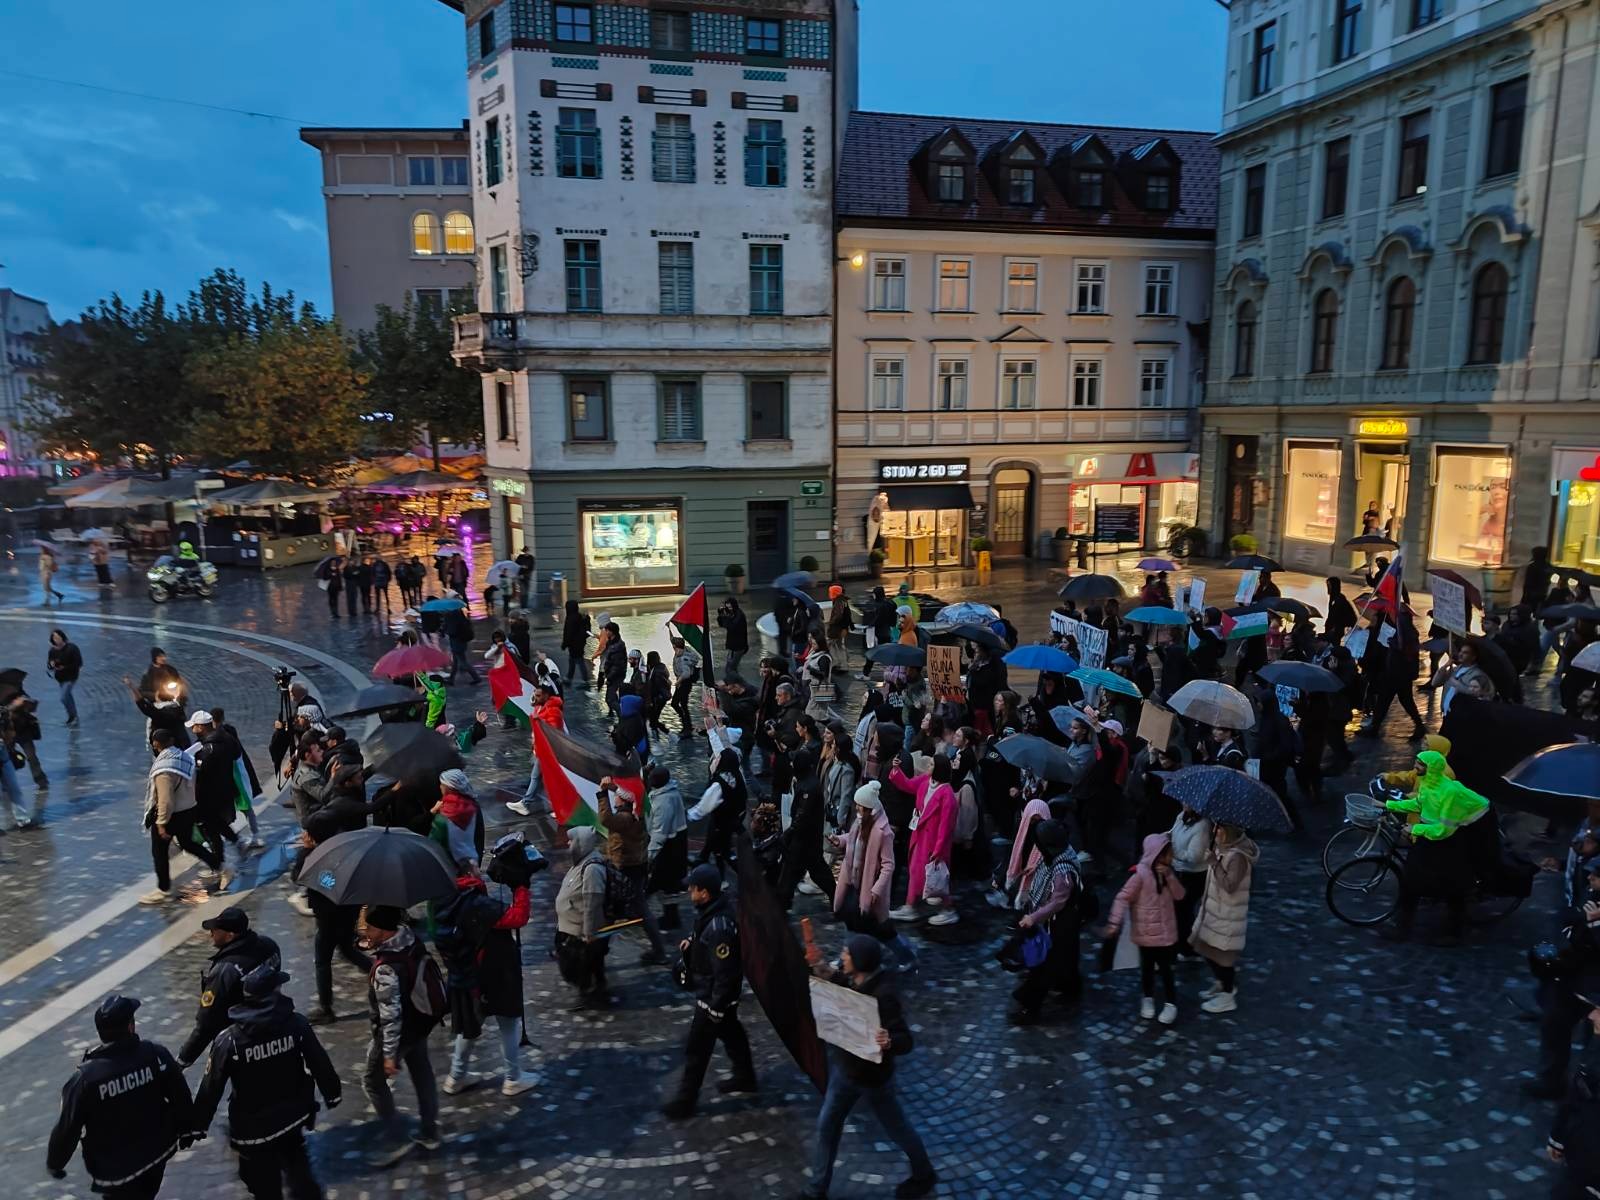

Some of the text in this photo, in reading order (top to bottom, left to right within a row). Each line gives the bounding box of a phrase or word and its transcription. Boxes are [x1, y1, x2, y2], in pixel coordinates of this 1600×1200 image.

[882, 465, 917, 479] STOW
[1126, 453, 1157, 478] A
[942, 647, 952, 659] NI
[942, 673, 951, 685] JE
[245, 1035, 295, 1063] POLICIJA
[99, 1066, 154, 1101] POLICIJA
